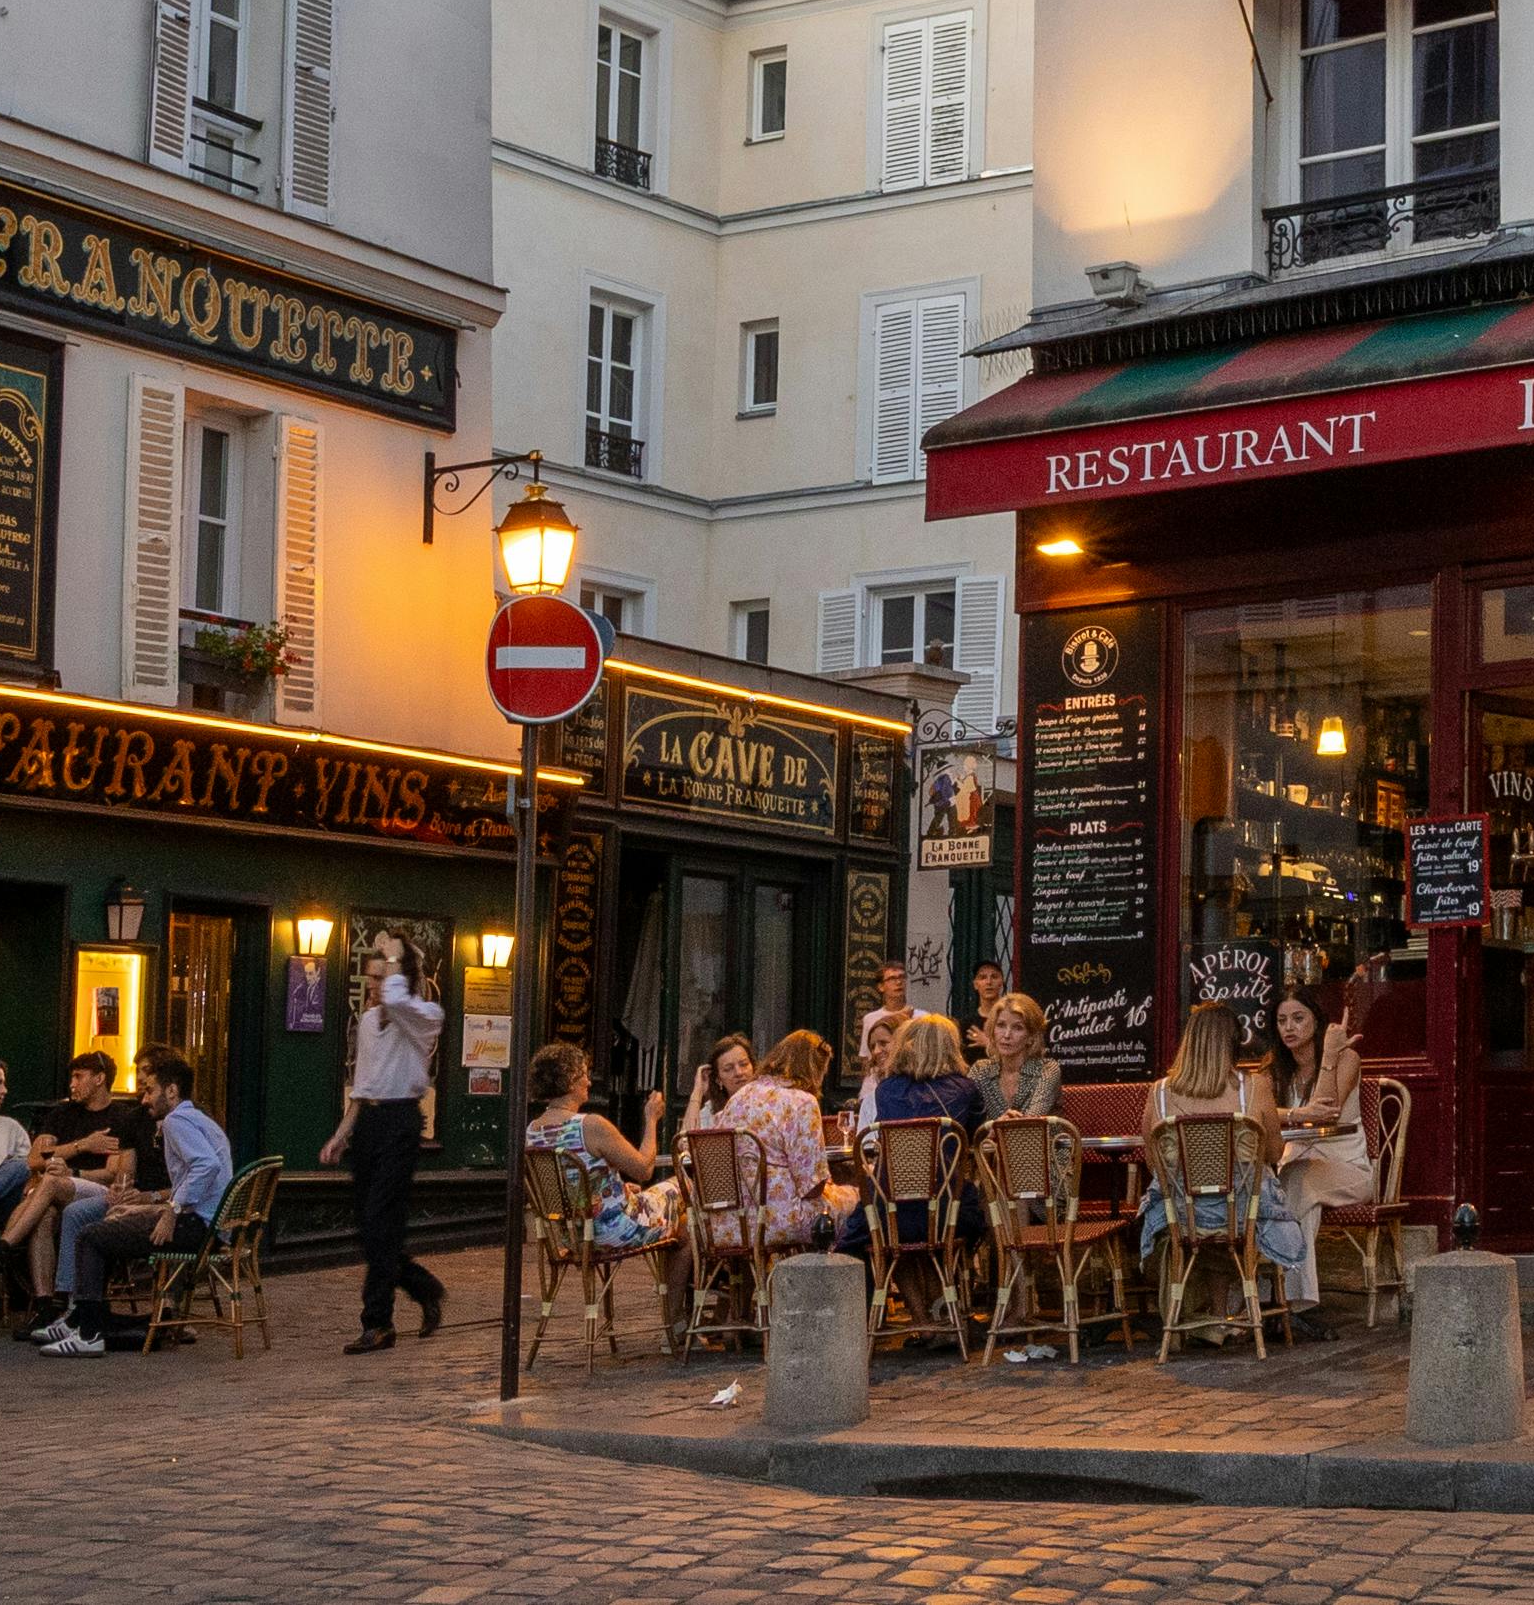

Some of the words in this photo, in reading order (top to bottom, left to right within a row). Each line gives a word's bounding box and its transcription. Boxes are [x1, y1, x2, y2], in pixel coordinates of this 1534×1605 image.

[1043, 409, 1378, 494] RESTAURANT
[1065, 693, 1116, 711] ENTRÉES
[659, 731, 684, 766] LA
[689, 729, 776, 789] CAVE
[783, 754, 808, 788] DE
[315, 755, 429, 831] VINS
[658, 771, 678, 796] LA
[682, 776, 723, 802] BONNE
[724, 783, 806, 816] FRANQUETTE
[1488, 771, 1534, 803] VINS
[1069, 819, 1107, 835] PLATS
[1409, 825, 1426, 836] LES
[1454, 820, 1483, 832] CARTE
[925, 851, 986, 864] FRANQUETTE
[1441, 838, 1452, 849] de
[1434, 895, 1459, 909] frites
[1189, 944, 1270, 984] APÉROL
[1199, 975, 1273, 1006] Spritz
[1049, 1015, 1116, 1043] Consulat
